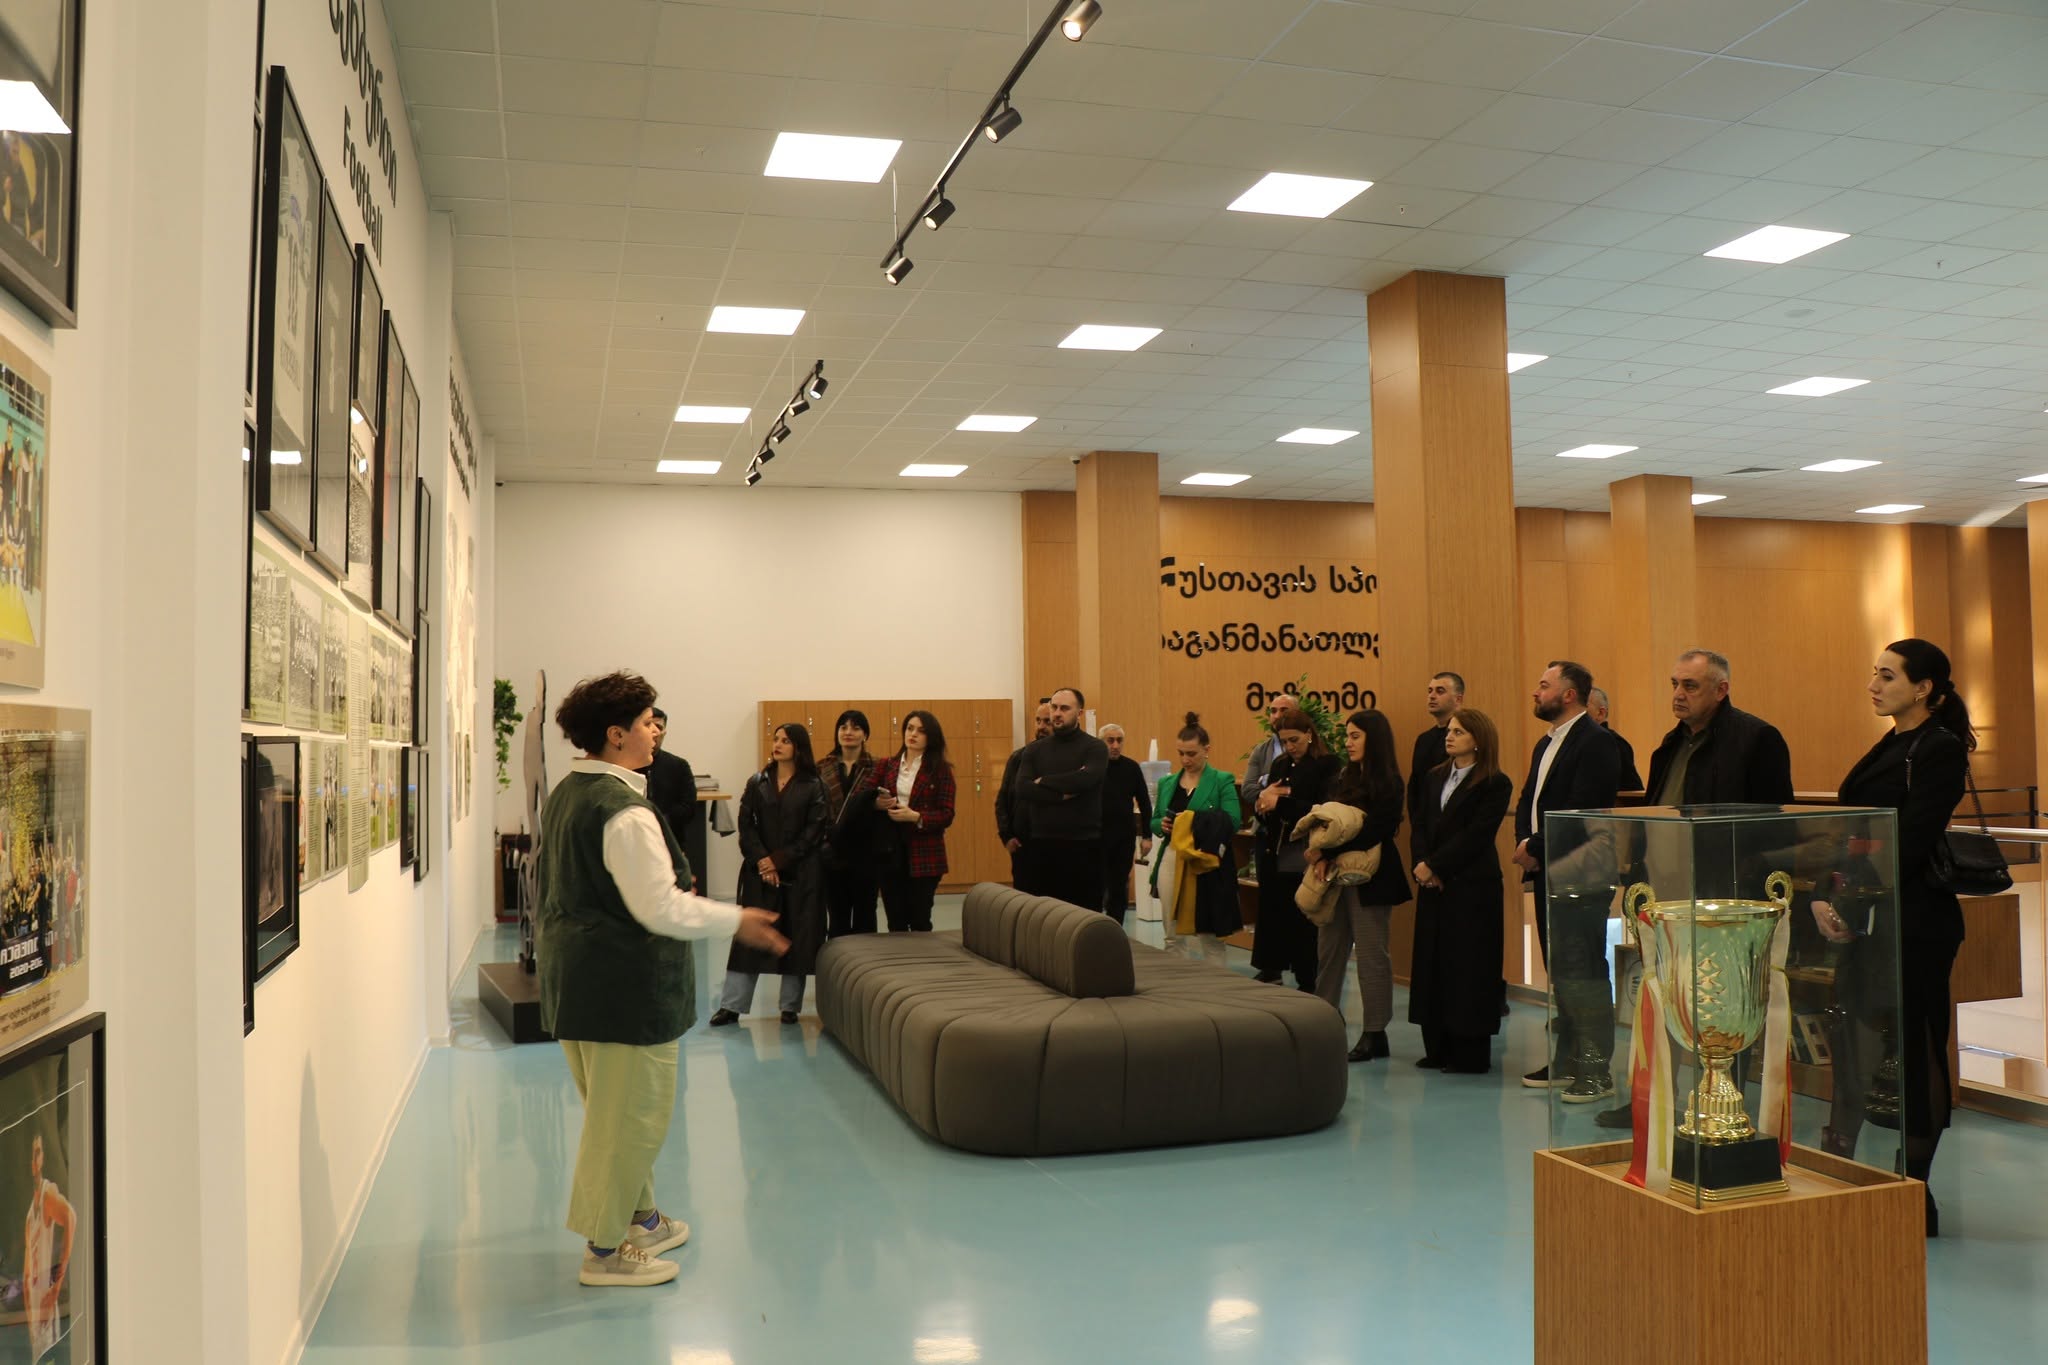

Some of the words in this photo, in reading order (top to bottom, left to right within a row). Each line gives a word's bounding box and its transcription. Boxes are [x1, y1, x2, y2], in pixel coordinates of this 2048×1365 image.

[343, 105, 383, 267] Football
[1160, 557, 1317, 599] უსთავის
[1161, 622, 1379, 659] აგანმანათლ
